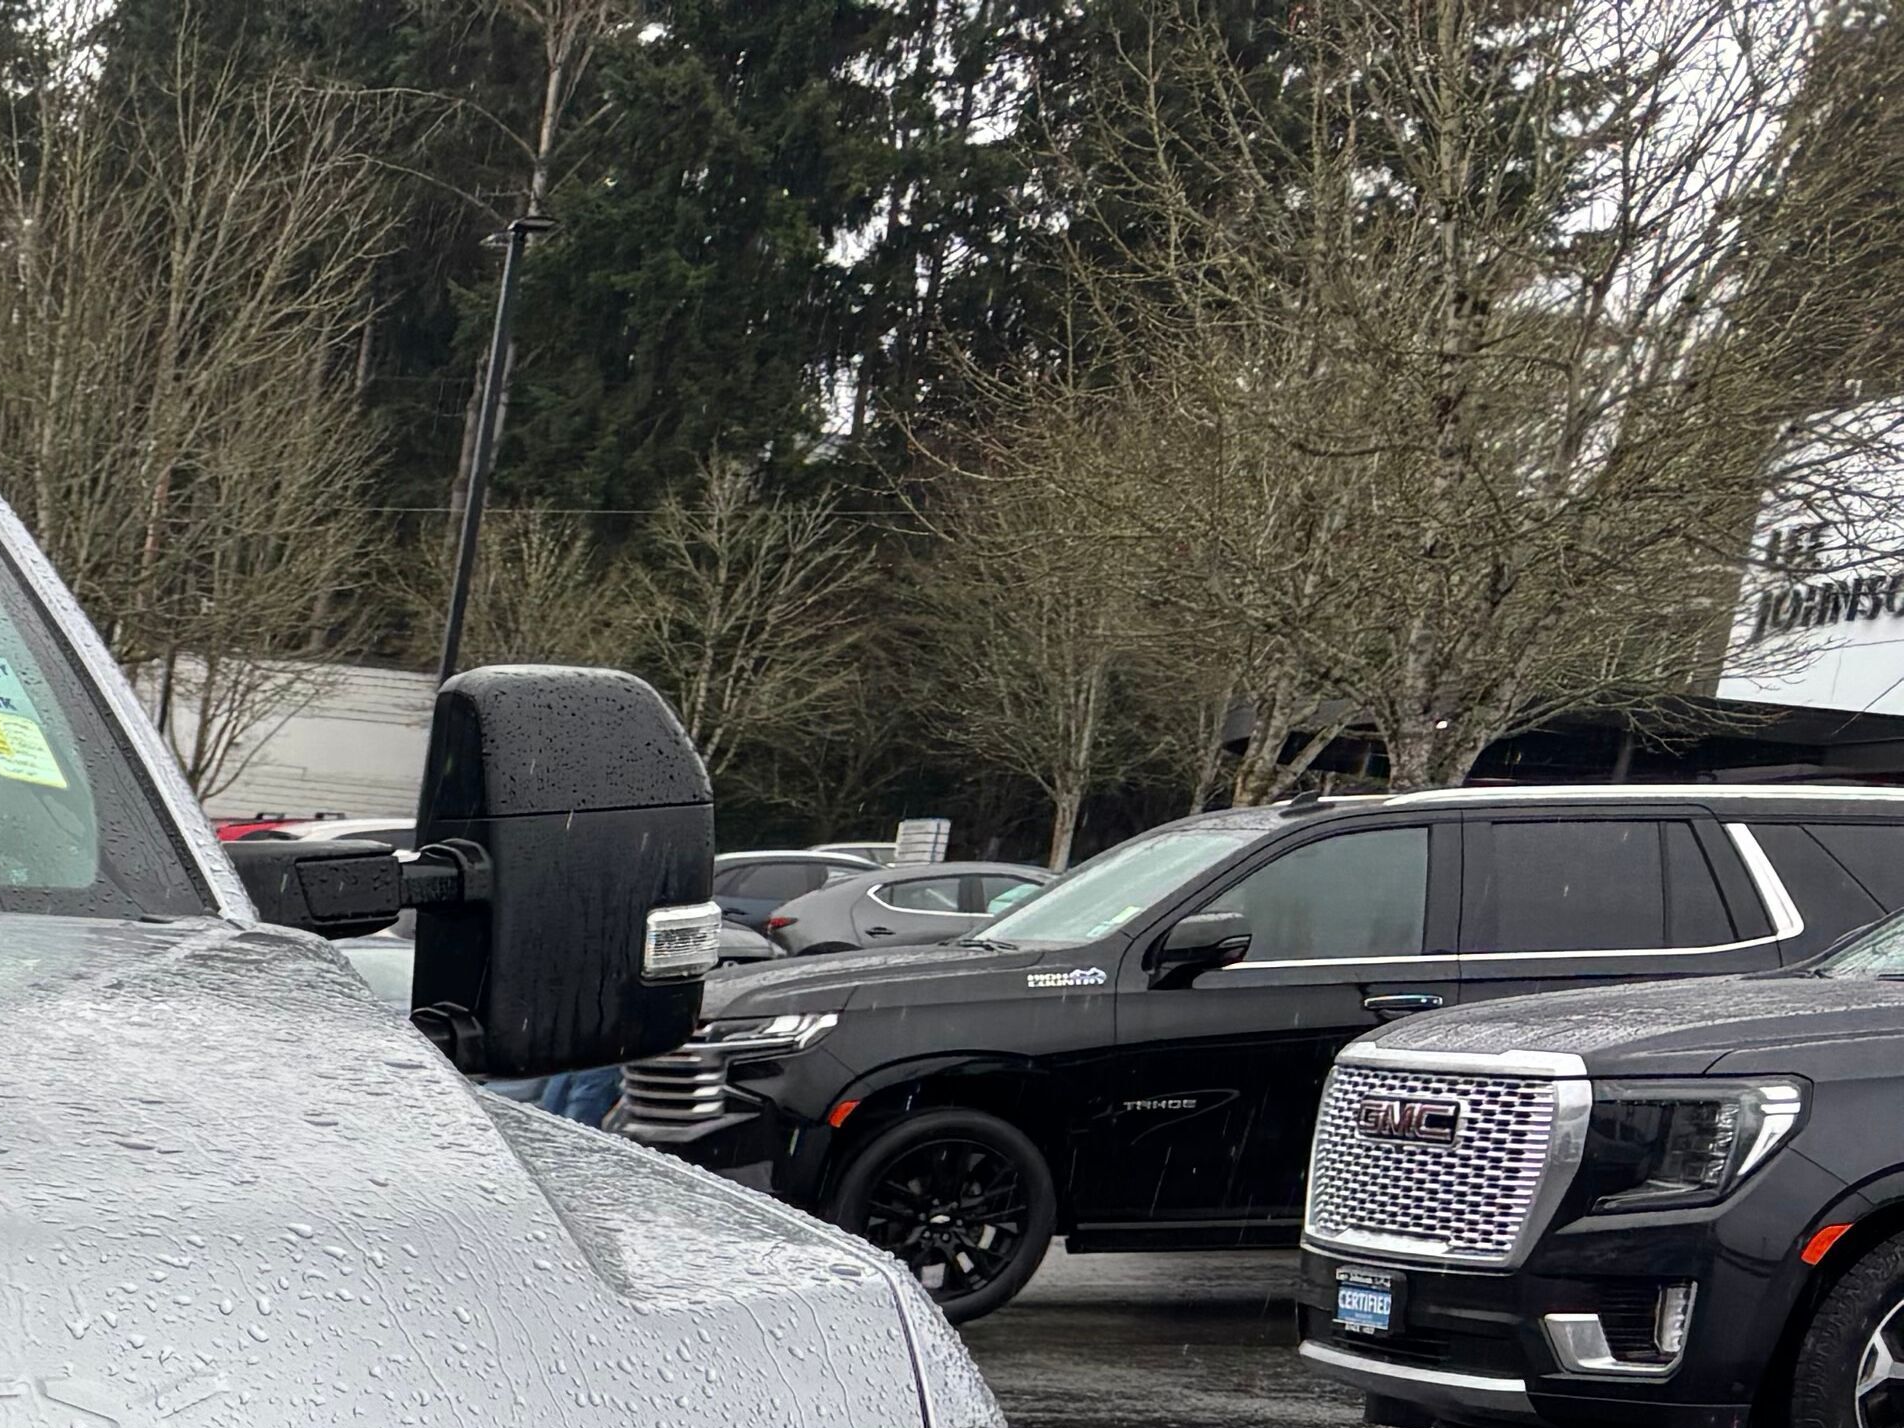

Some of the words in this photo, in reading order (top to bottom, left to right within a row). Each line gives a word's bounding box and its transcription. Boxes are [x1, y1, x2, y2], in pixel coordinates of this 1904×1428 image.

[1122, 1099, 1197, 1111] TAHOE
[1357, 1100, 1457, 1141] GMC
[1338, 1289, 1392, 1316] CERTIFIED
